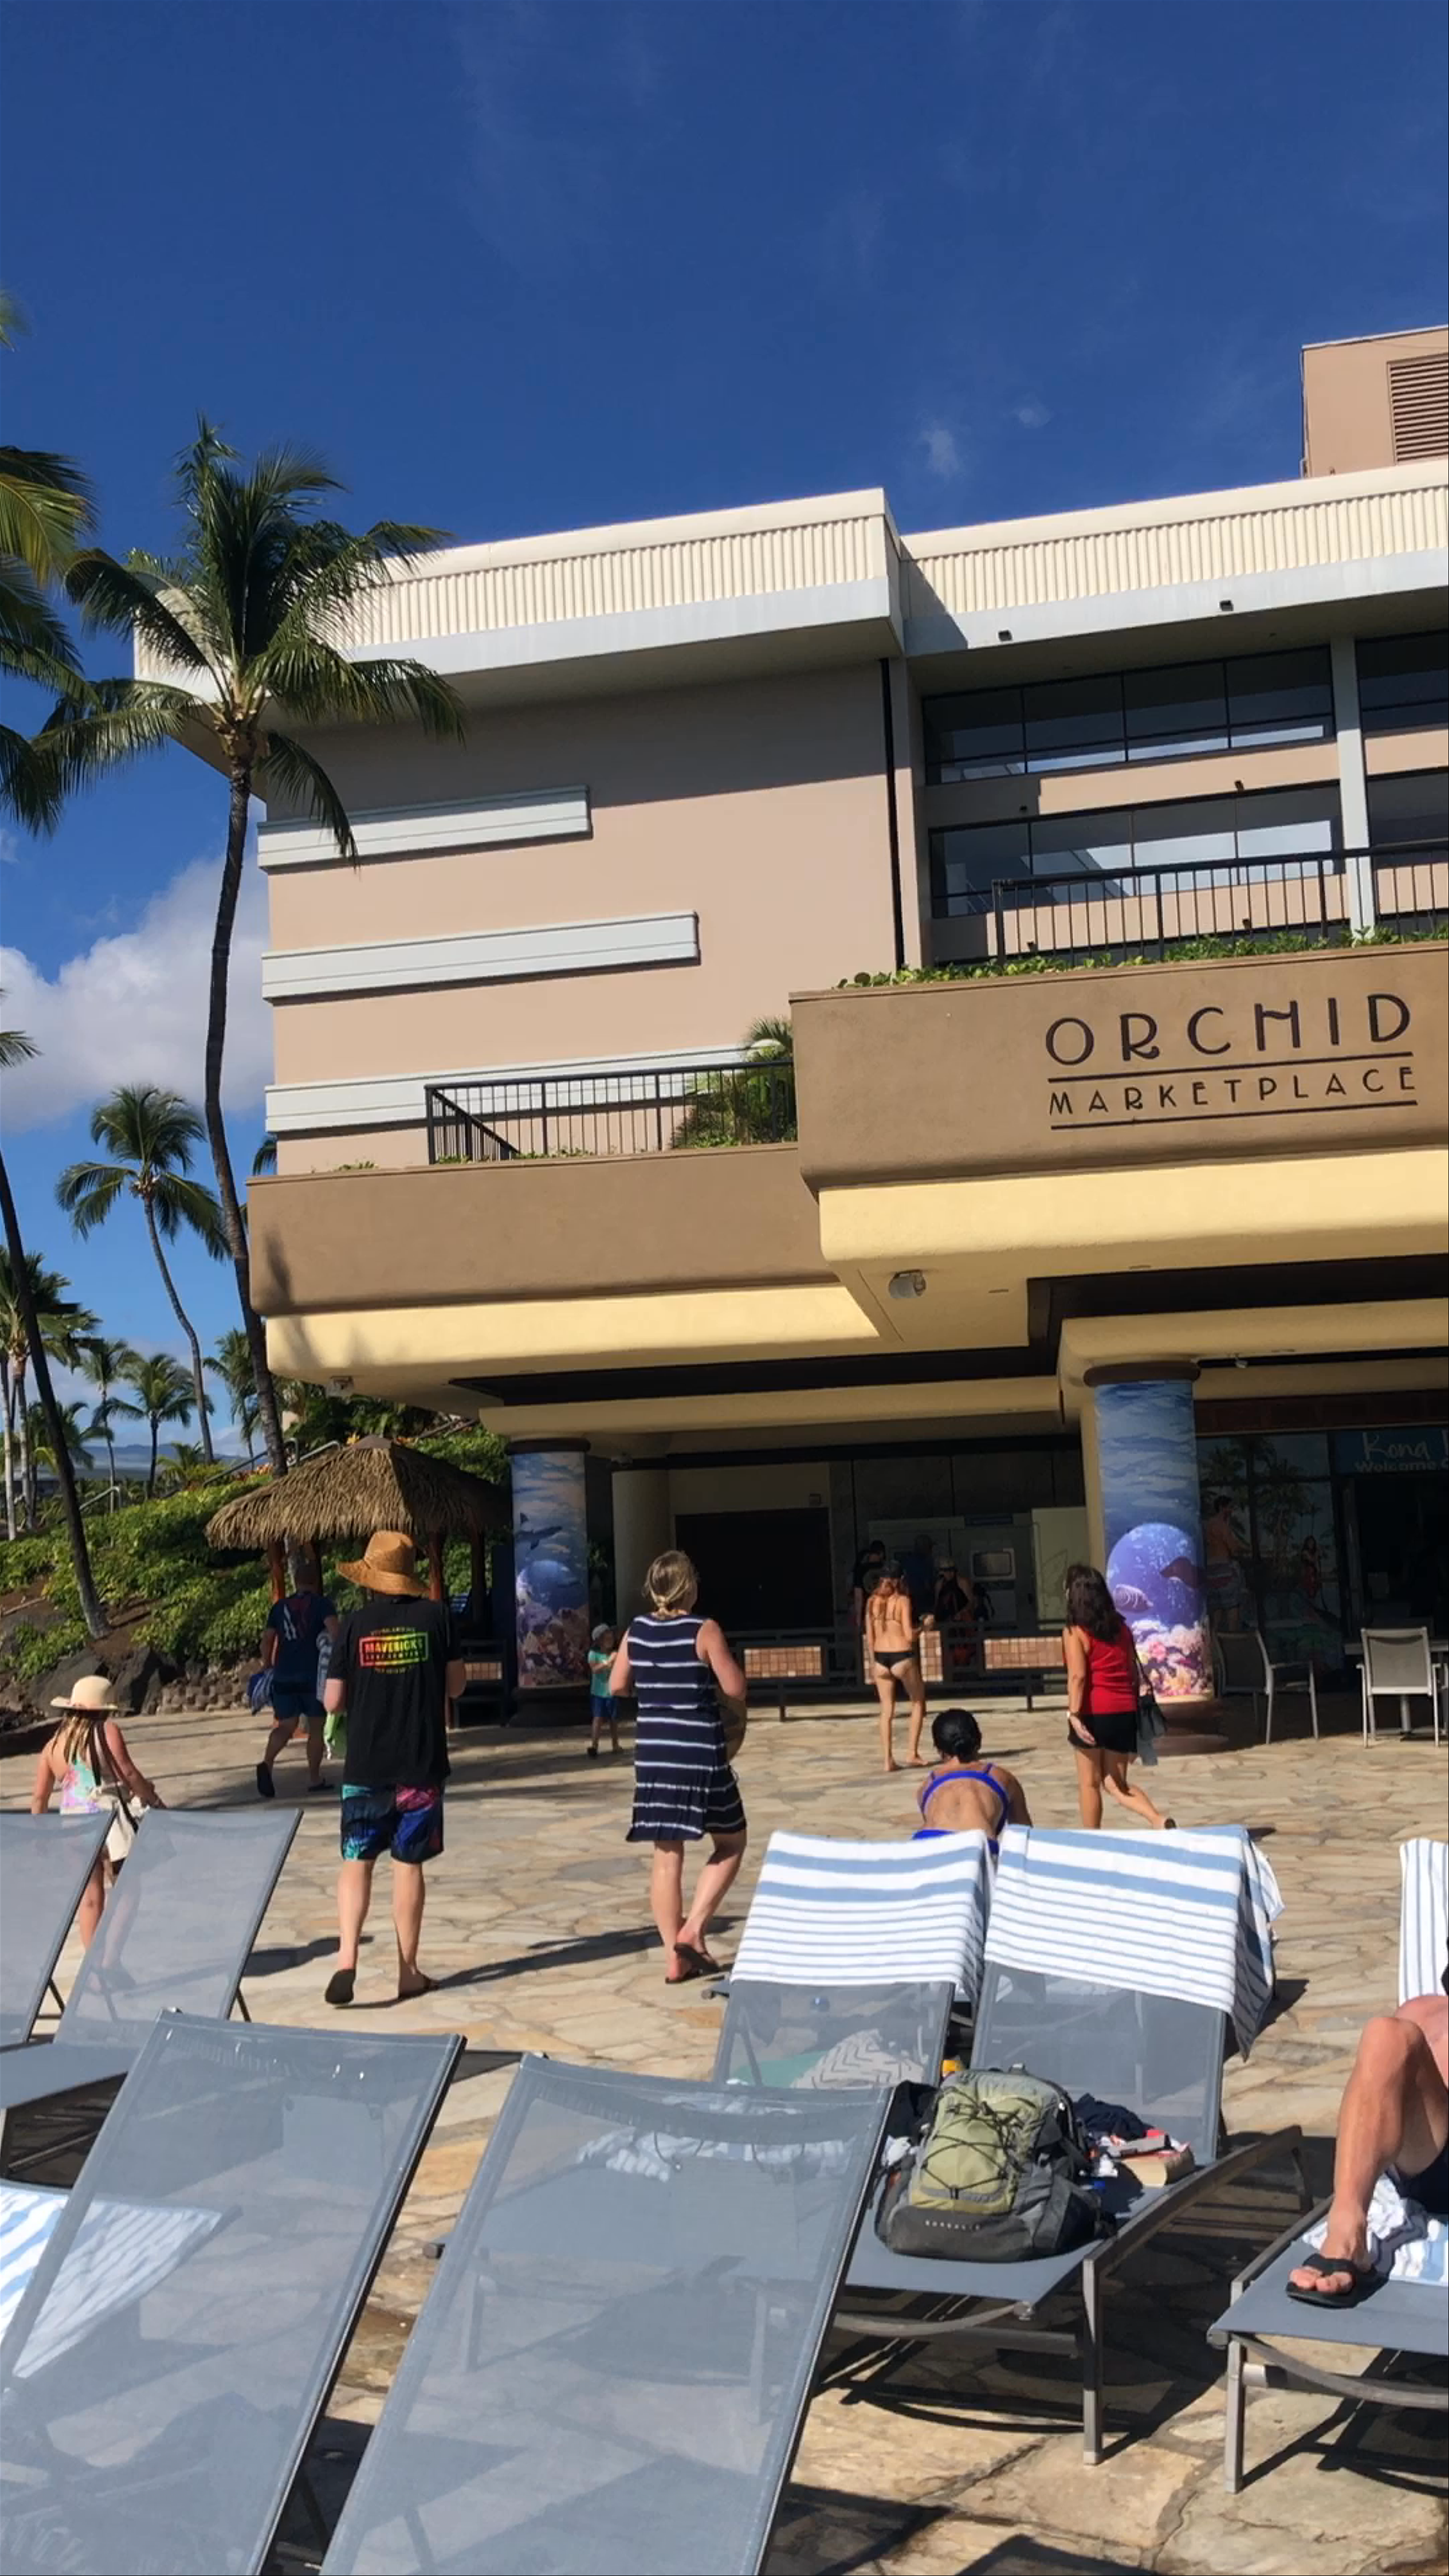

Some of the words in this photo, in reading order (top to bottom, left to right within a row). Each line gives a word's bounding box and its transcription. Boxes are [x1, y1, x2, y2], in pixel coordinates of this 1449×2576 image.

[1046, 994, 1411, 1065] ORCHID
[1049, 1067, 1415, 1115] MARKETPLACE
[1362, 1432, 1430, 1461] Kona
[1355, 1459, 1437, 1473] Welcome
